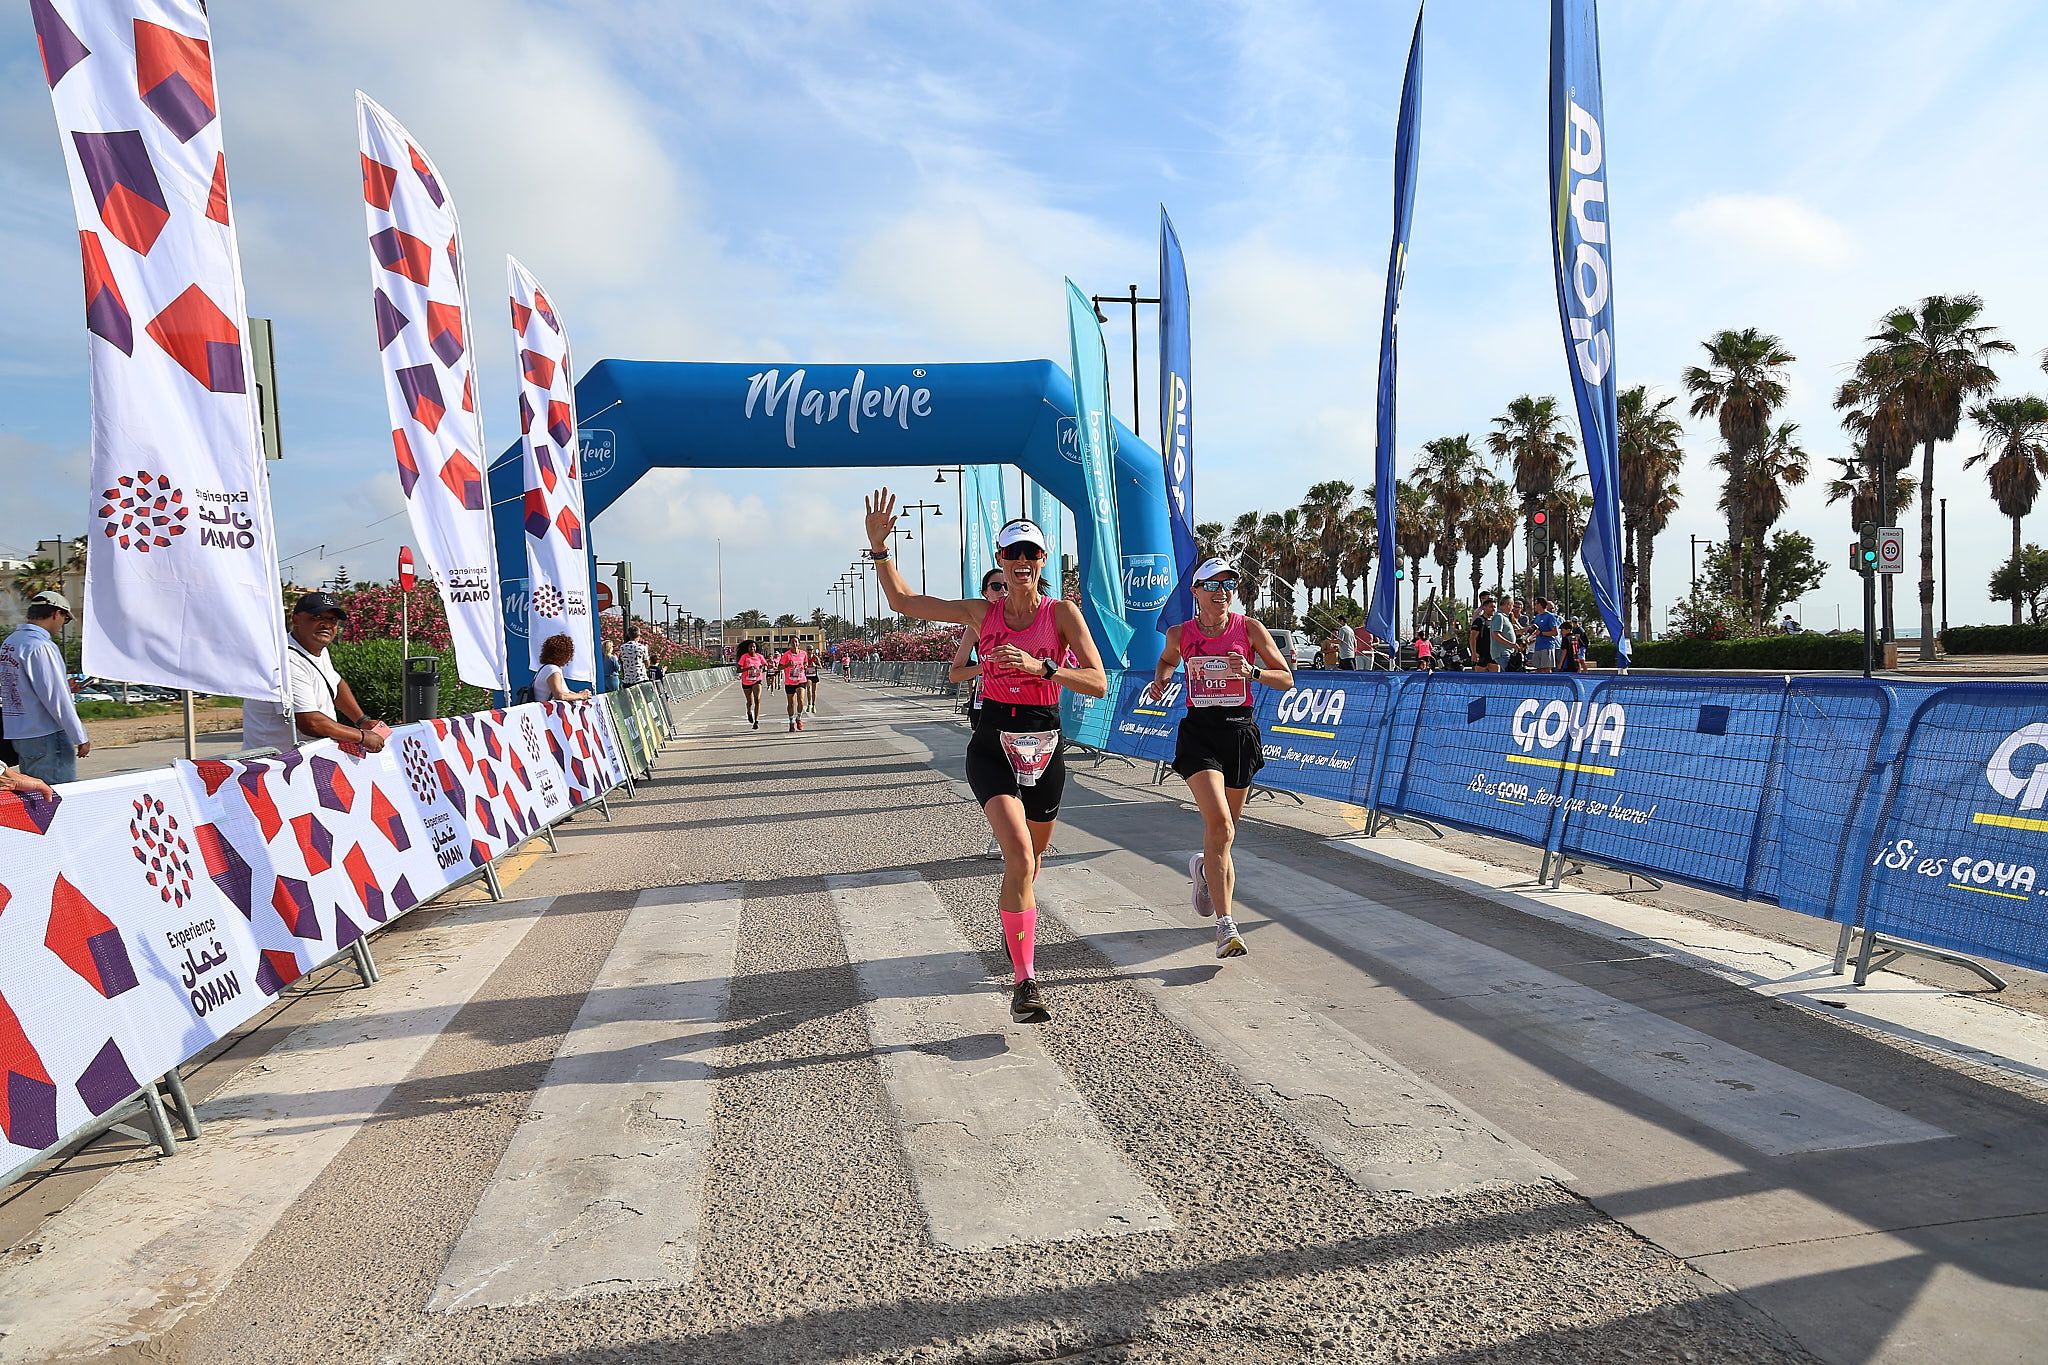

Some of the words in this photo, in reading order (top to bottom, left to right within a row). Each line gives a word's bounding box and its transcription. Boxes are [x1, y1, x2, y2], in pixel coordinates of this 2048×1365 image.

[1885, 546, 1896, 555] 30
[1206, 680, 1226, 688] 016
[1277, 687, 1345, 725] GOYA
[1512, 698, 1626, 757] GOYA
[1315, 754, 1329, 765] ser
[1328, 750, 1356, 770] bueno!
[1485, 782, 1497, 795] es
[1497, 781, 1529, 801] GOYA
[1562, 797, 1586, 822] que
[1586, 800, 1608, 816] ser
[1607, 793, 1657, 825] bueno!
[437, 844, 464, 870] OMAN
[1917, 857, 1948, 877] es
[1951, 856, 2036, 892] GOYA
[165, 918, 216, 949] Experience
[190, 970, 242, 1018] OMAN
